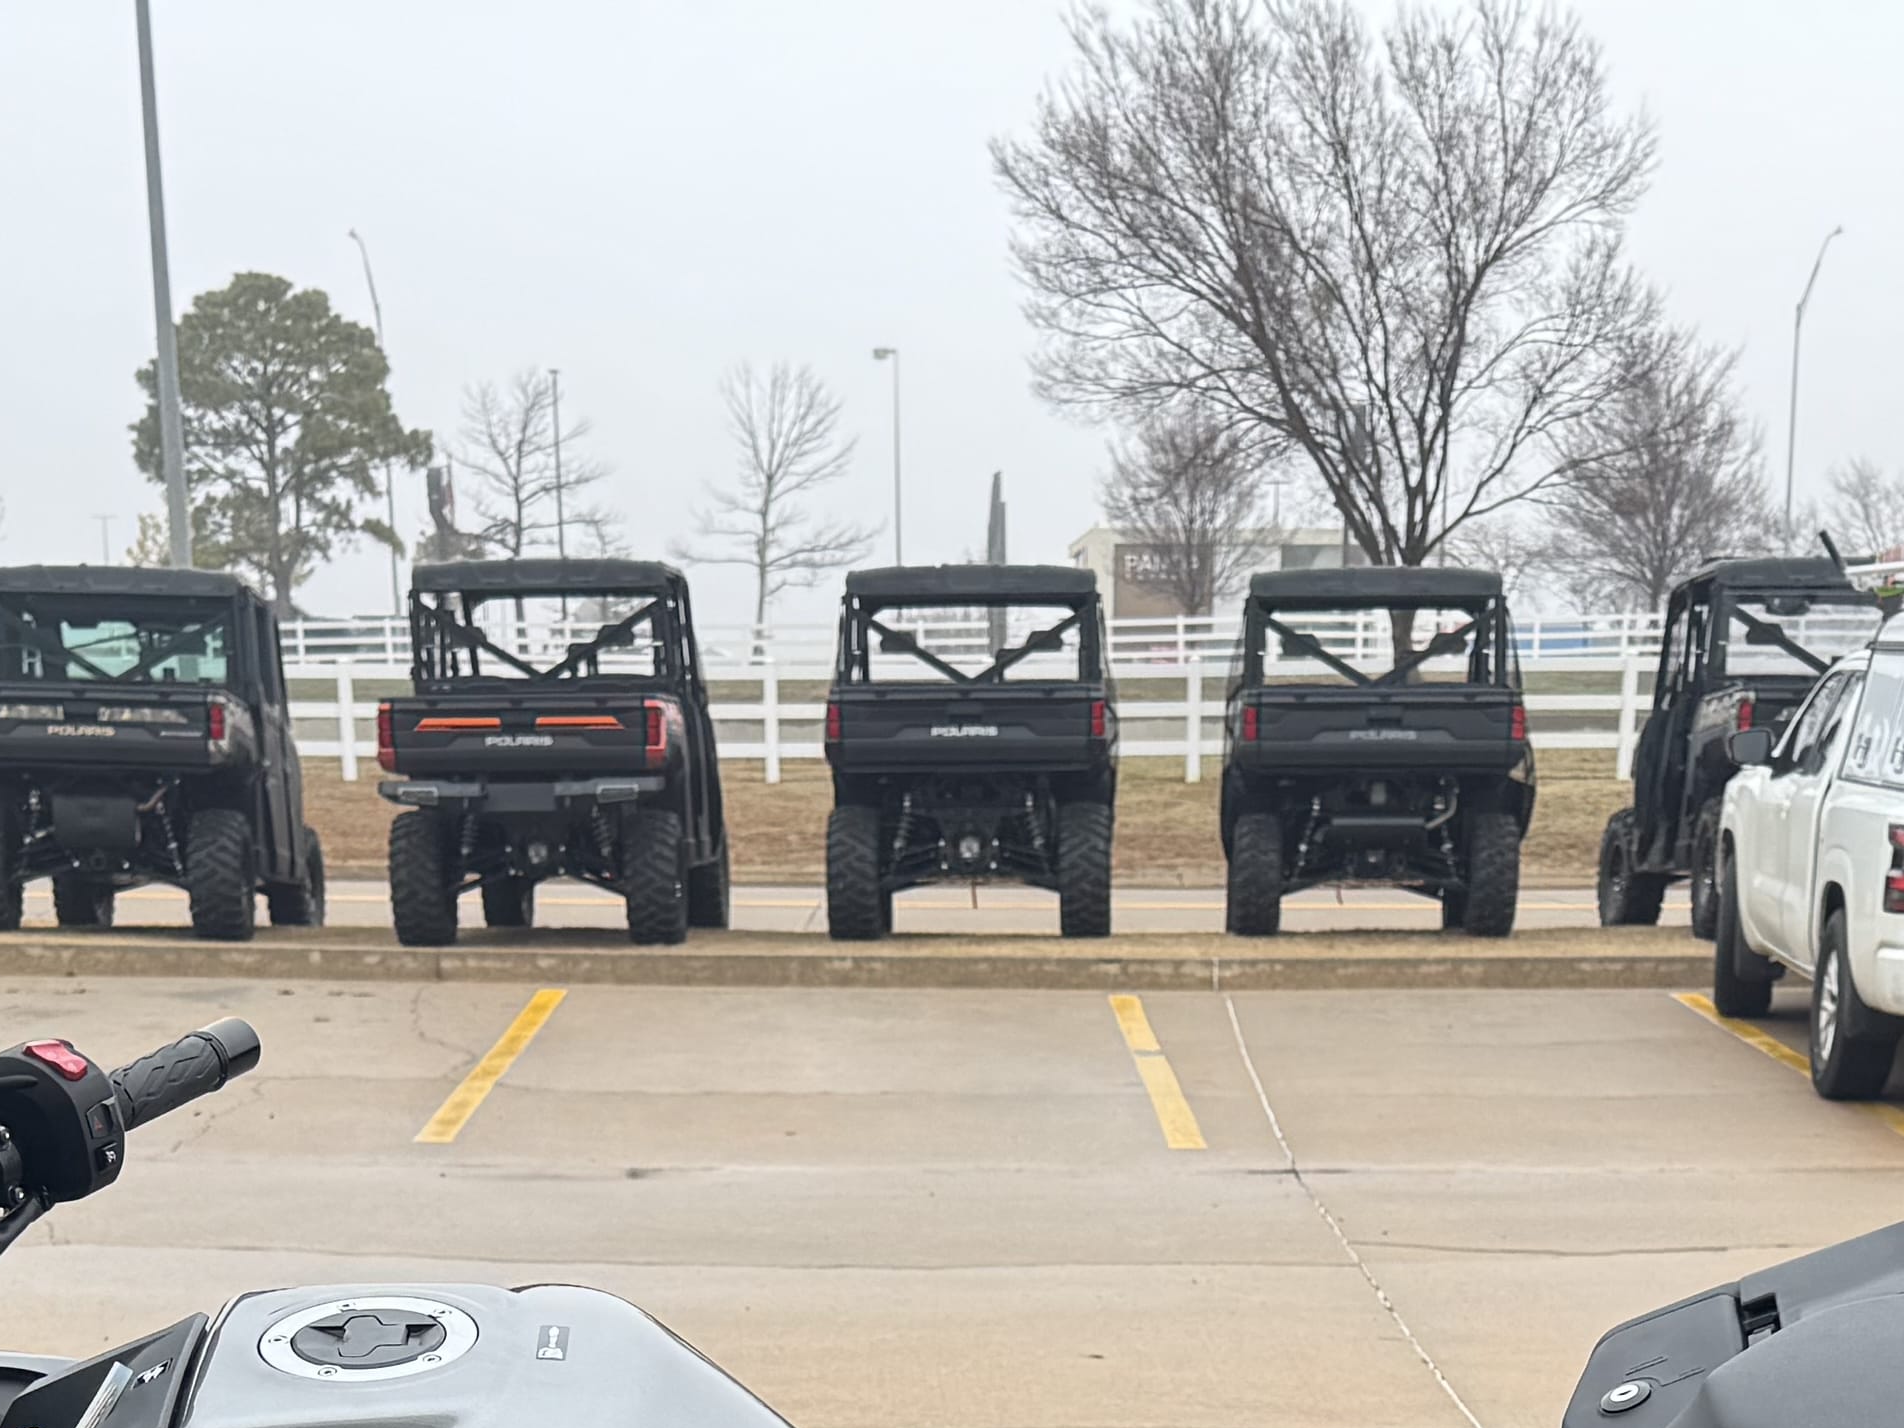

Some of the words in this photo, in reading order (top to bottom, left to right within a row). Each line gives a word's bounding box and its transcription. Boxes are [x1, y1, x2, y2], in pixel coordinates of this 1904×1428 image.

[47, 724, 116, 738] POLARIS
[930, 725, 999, 737] POLARIS
[1348, 729, 1417, 741] POLARIS
[484, 736, 554, 747] POLARIS
